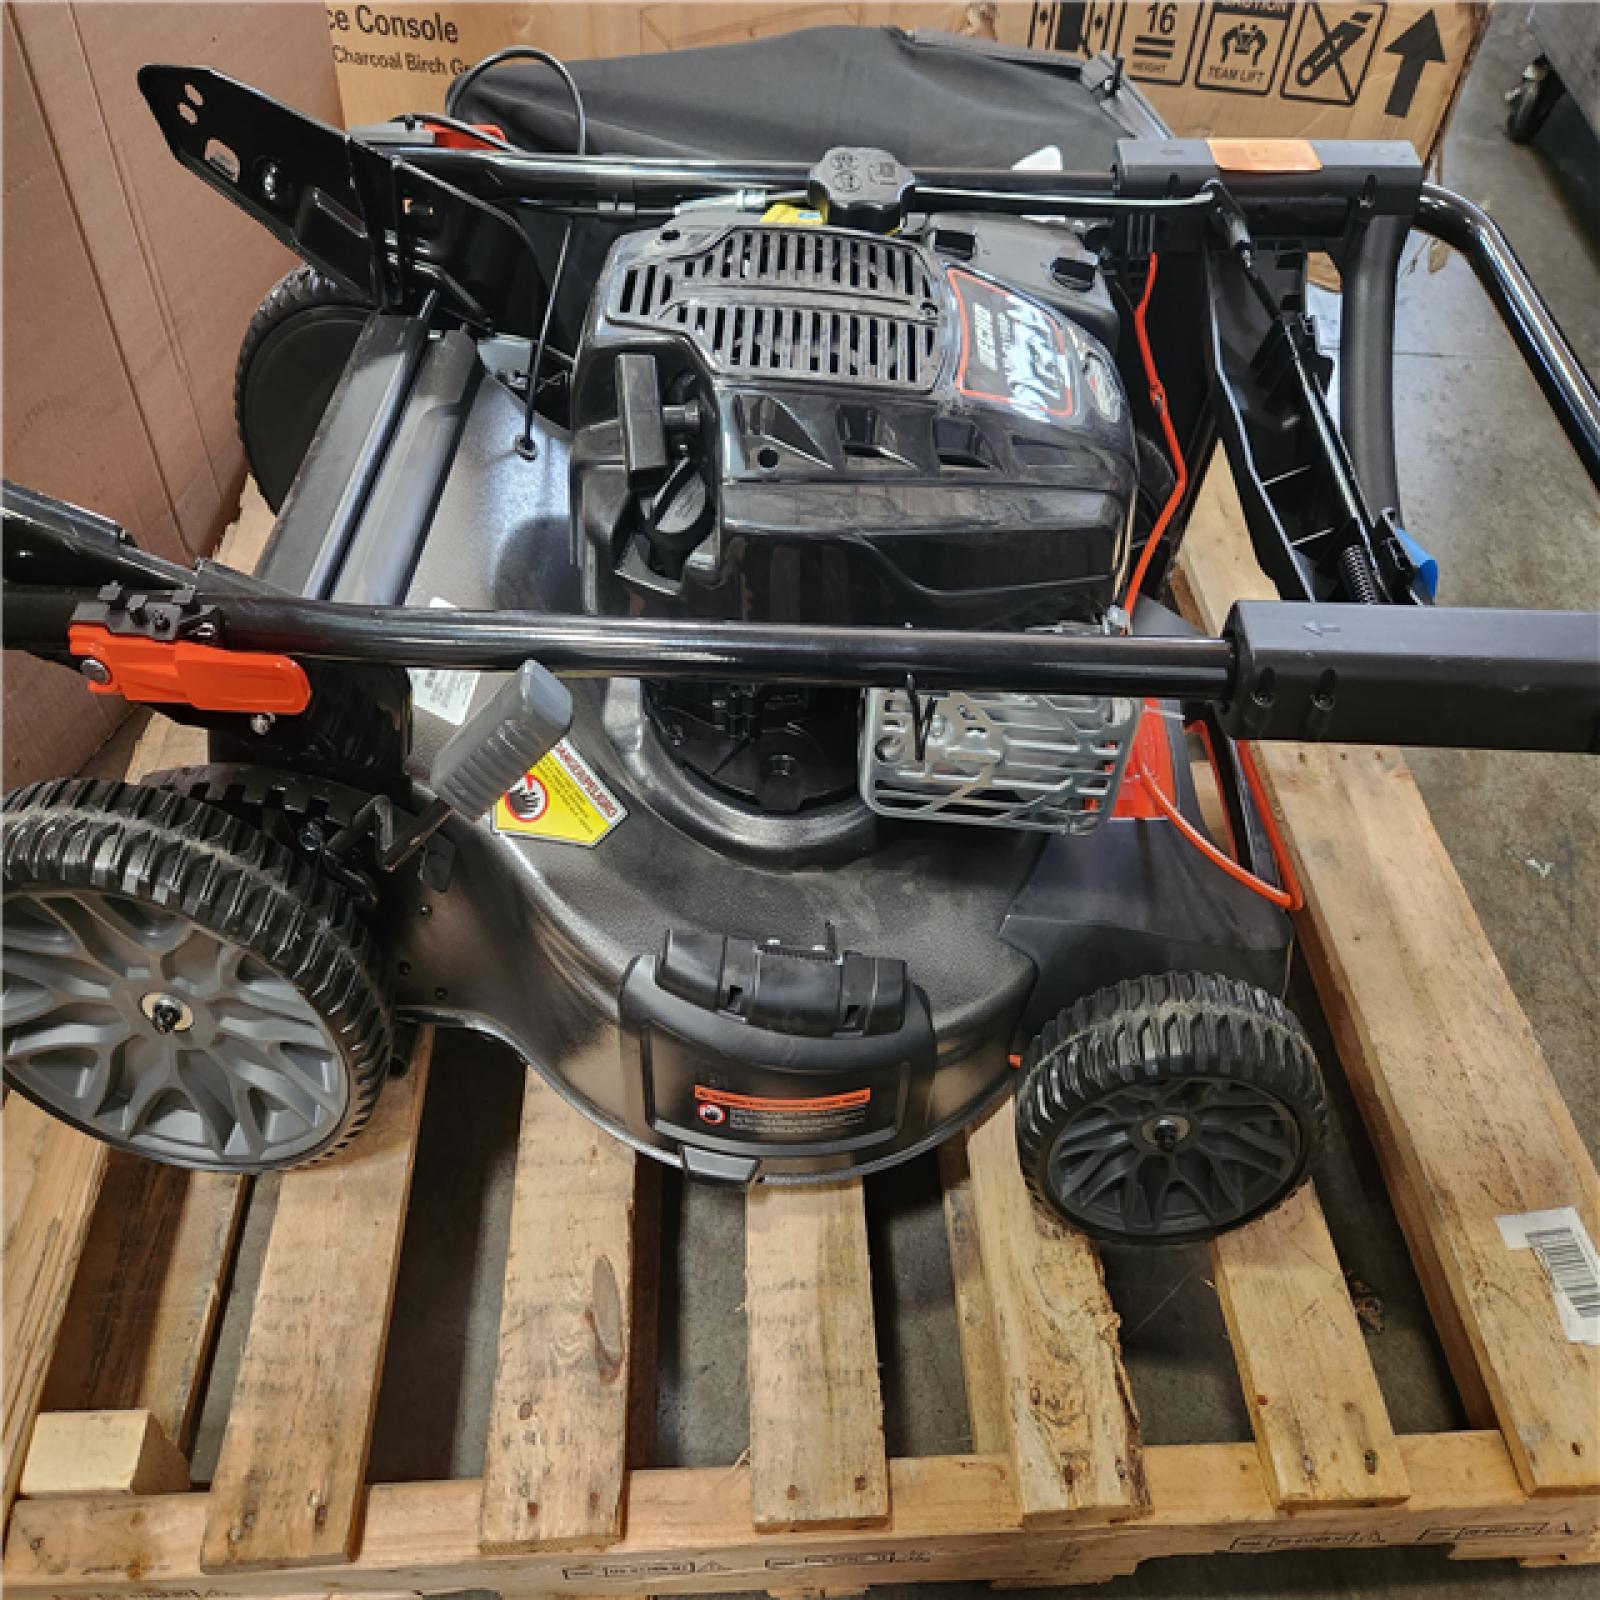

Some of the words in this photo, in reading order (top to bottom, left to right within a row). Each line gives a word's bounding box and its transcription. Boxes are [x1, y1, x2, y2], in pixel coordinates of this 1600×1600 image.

[355, 4, 458, 43] Console
[1147, 2, 1178, 35] 16
[332, 44, 402, 70] Charcoal
[404, 51, 448, 75] Birch
[1132, 61, 1168, 75] HEIGHT
[1207, 65, 1238, 80] TEAM
[1239, 69, 1266, 83] LIFT
